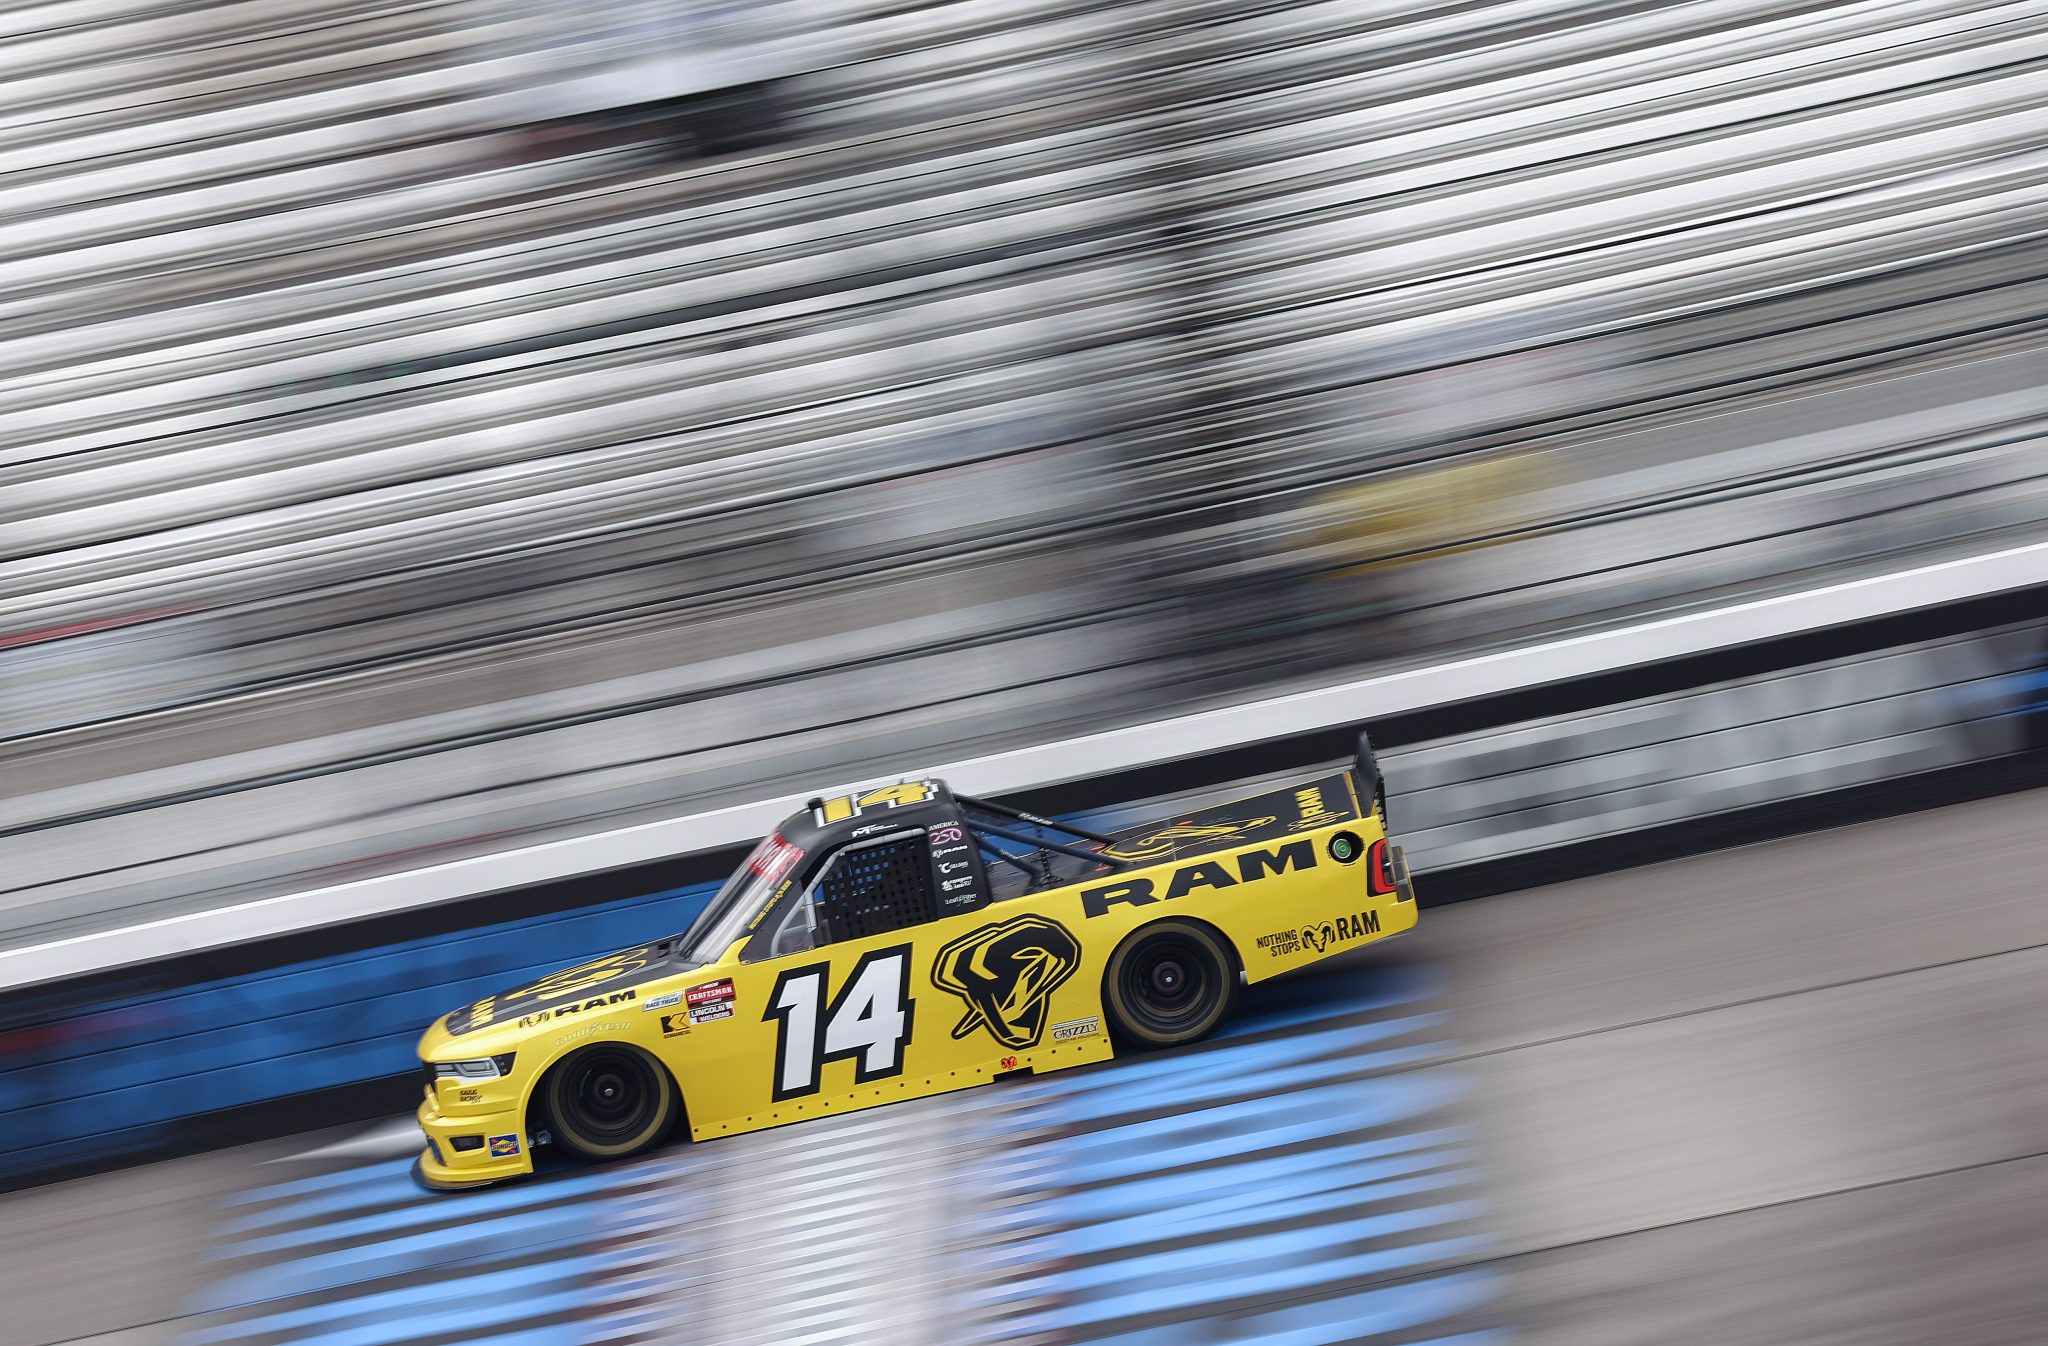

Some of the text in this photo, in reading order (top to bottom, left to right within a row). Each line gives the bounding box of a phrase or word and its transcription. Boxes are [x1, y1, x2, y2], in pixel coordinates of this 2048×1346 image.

[812, 780, 940, 828] 14
[1294, 786, 1326, 819] RAM
[928, 820, 959, 831] AMERICA
[928, 827, 963, 846] 250
[1081, 839, 1317, 919] RAM
[1336, 909, 1381, 941] RAM
[1256, 929, 1298, 948] NOTHING
[1270, 940, 1301, 957] STOPS
[688, 986, 733, 1001] CRAFTSMAN
[555, 990, 636, 1017] RAM
[691, 1003, 726, 1017] LINCOLN
[761, 942, 917, 1104] 14
[1053, 1022, 1099, 1040] GRIZZLY
[491, 1141, 519, 1151] SUNOCO
